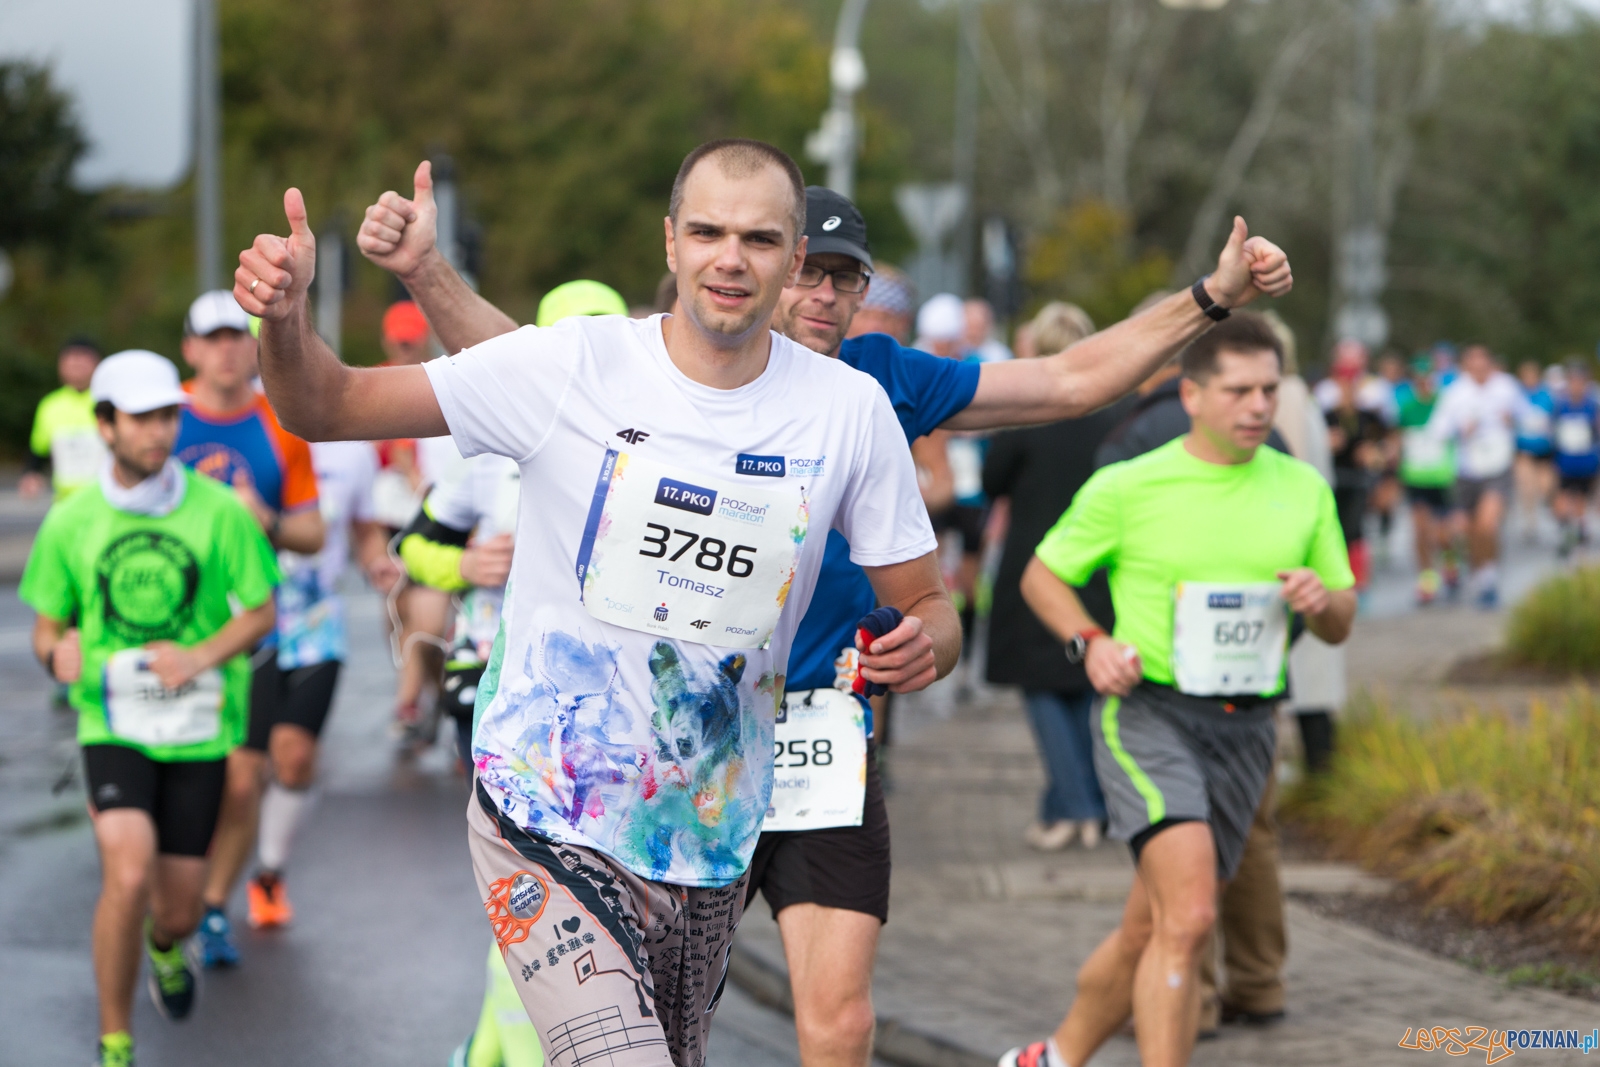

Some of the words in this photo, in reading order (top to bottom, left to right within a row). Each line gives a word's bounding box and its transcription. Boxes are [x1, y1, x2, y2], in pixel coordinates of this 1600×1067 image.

[616, 428, 650, 445] 4F
[741, 460, 755, 471] 17.
[757, 461, 782, 472] PKO
[790, 467, 825, 475] maraton
[662, 485, 680, 502] 17.
[680, 490, 711, 508] PKO
[718, 507, 765, 524] maraton
[639, 522, 758, 578] 3786
[656, 570, 725, 598] Tomasz
[607, 600, 635, 613] posir
[690, 619, 711, 630] 4F
[1214, 621, 1264, 646] 607
[774, 776, 810, 789] aciej
[514, 893, 541, 913] SQUAD
[546, 932, 596, 967] game
